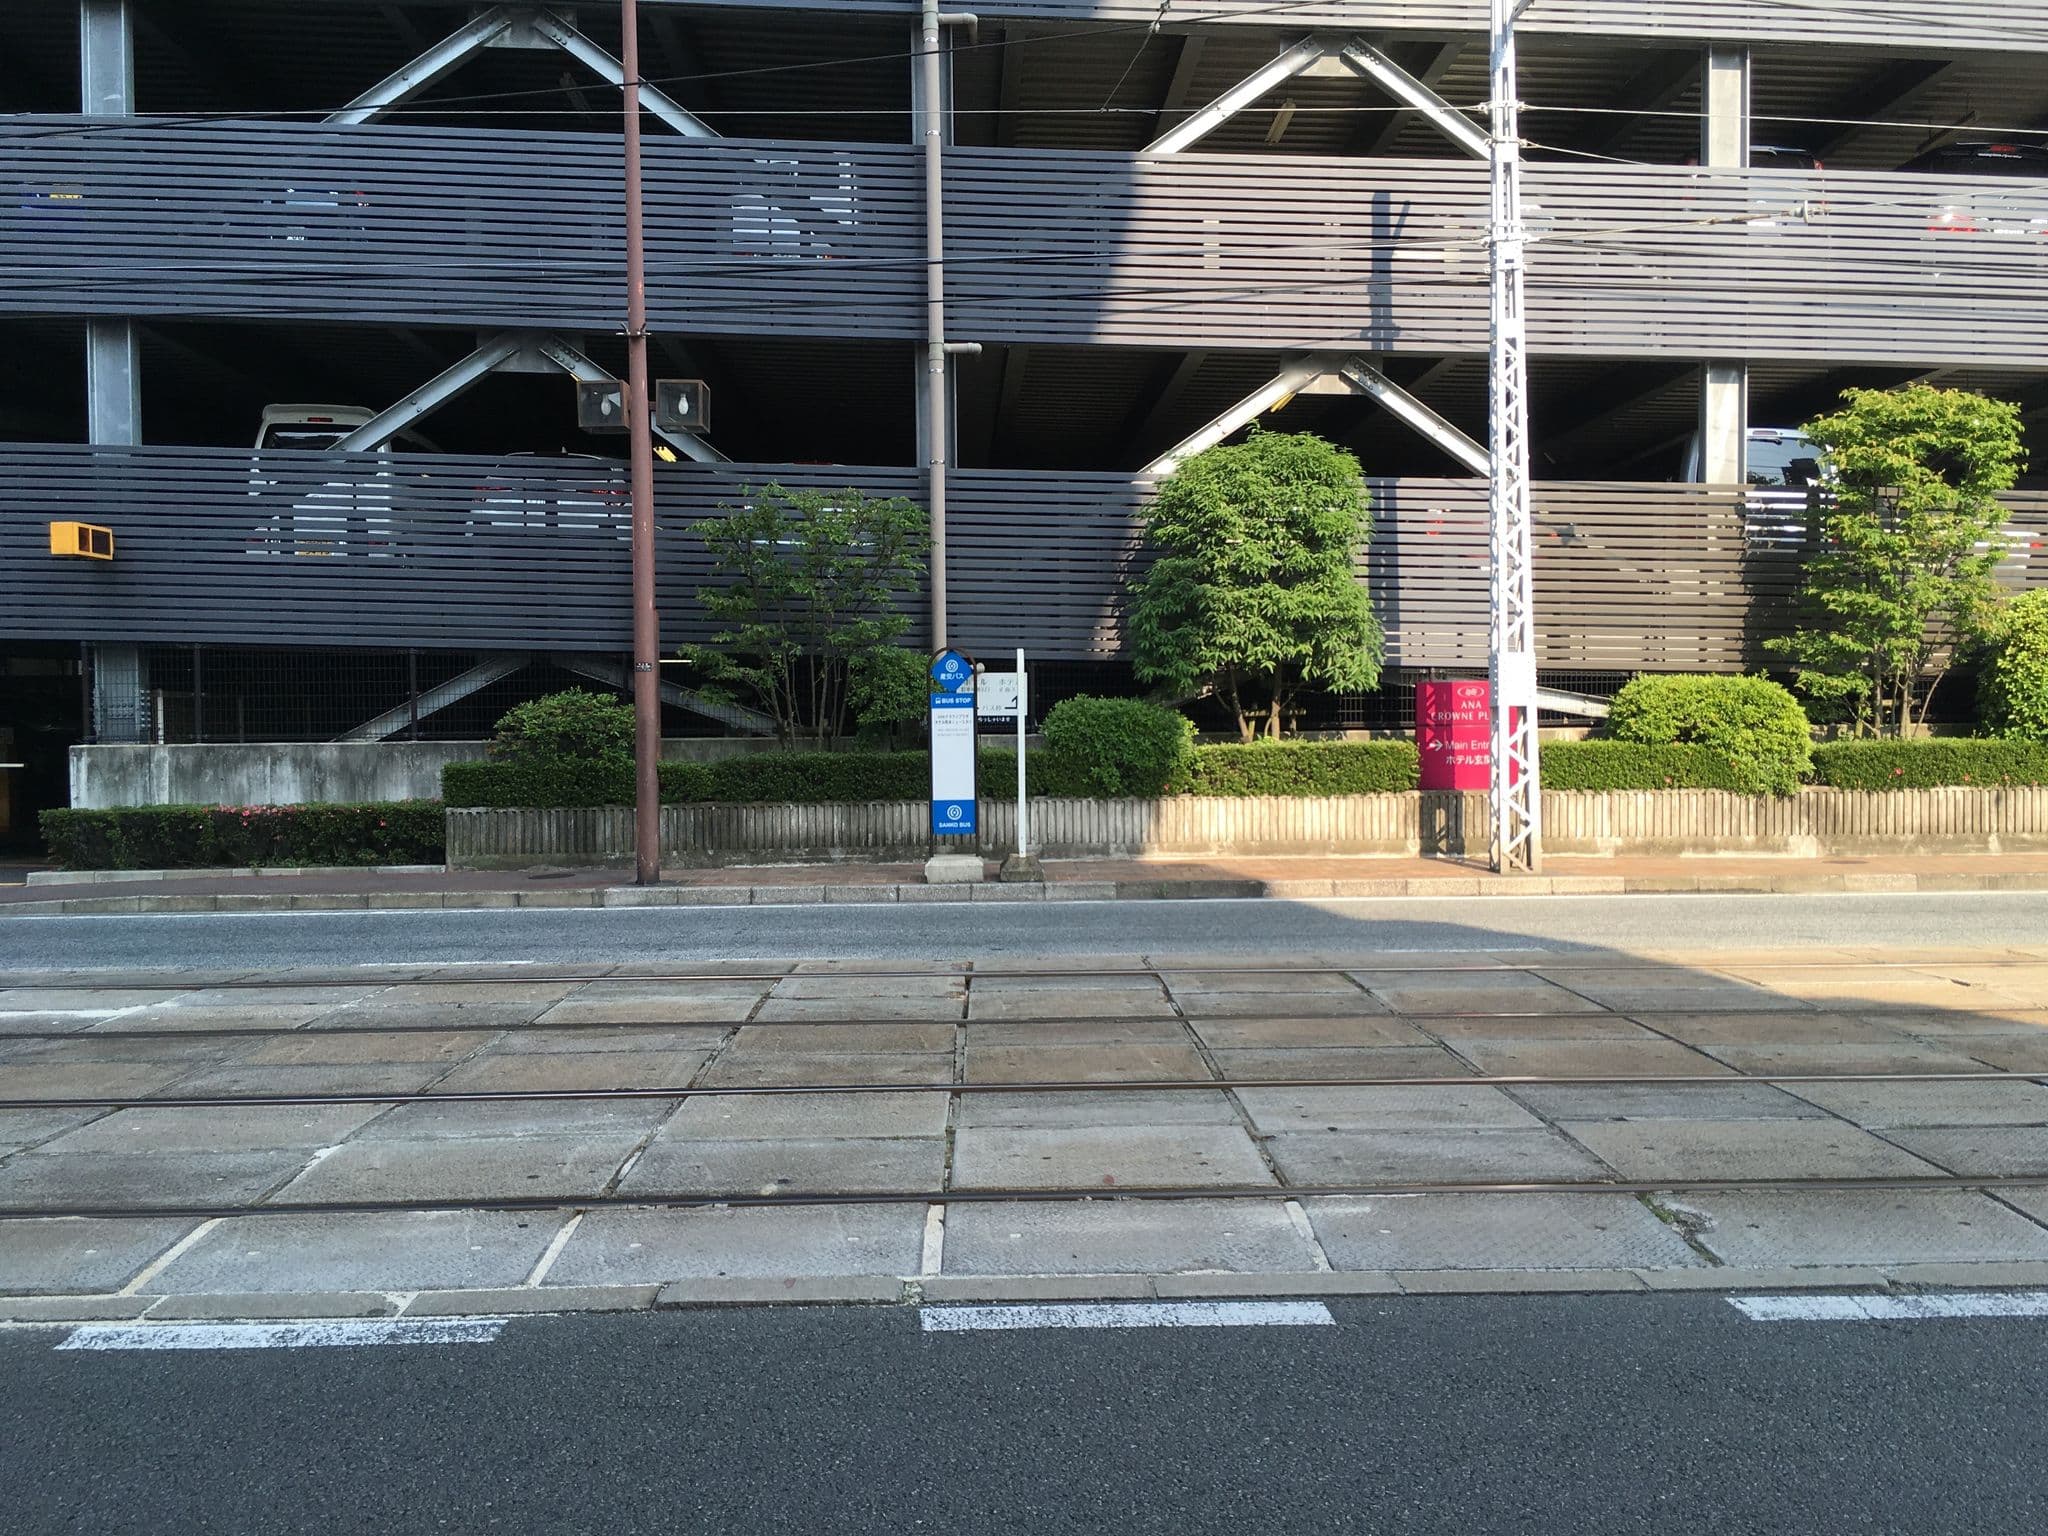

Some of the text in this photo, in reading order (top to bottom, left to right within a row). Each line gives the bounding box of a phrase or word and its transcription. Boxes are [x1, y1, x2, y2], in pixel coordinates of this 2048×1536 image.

[1460, 701, 1482, 709] ANA
[1430, 711, 1474, 720] CROWNE
[1445, 740, 1468, 750] Main
